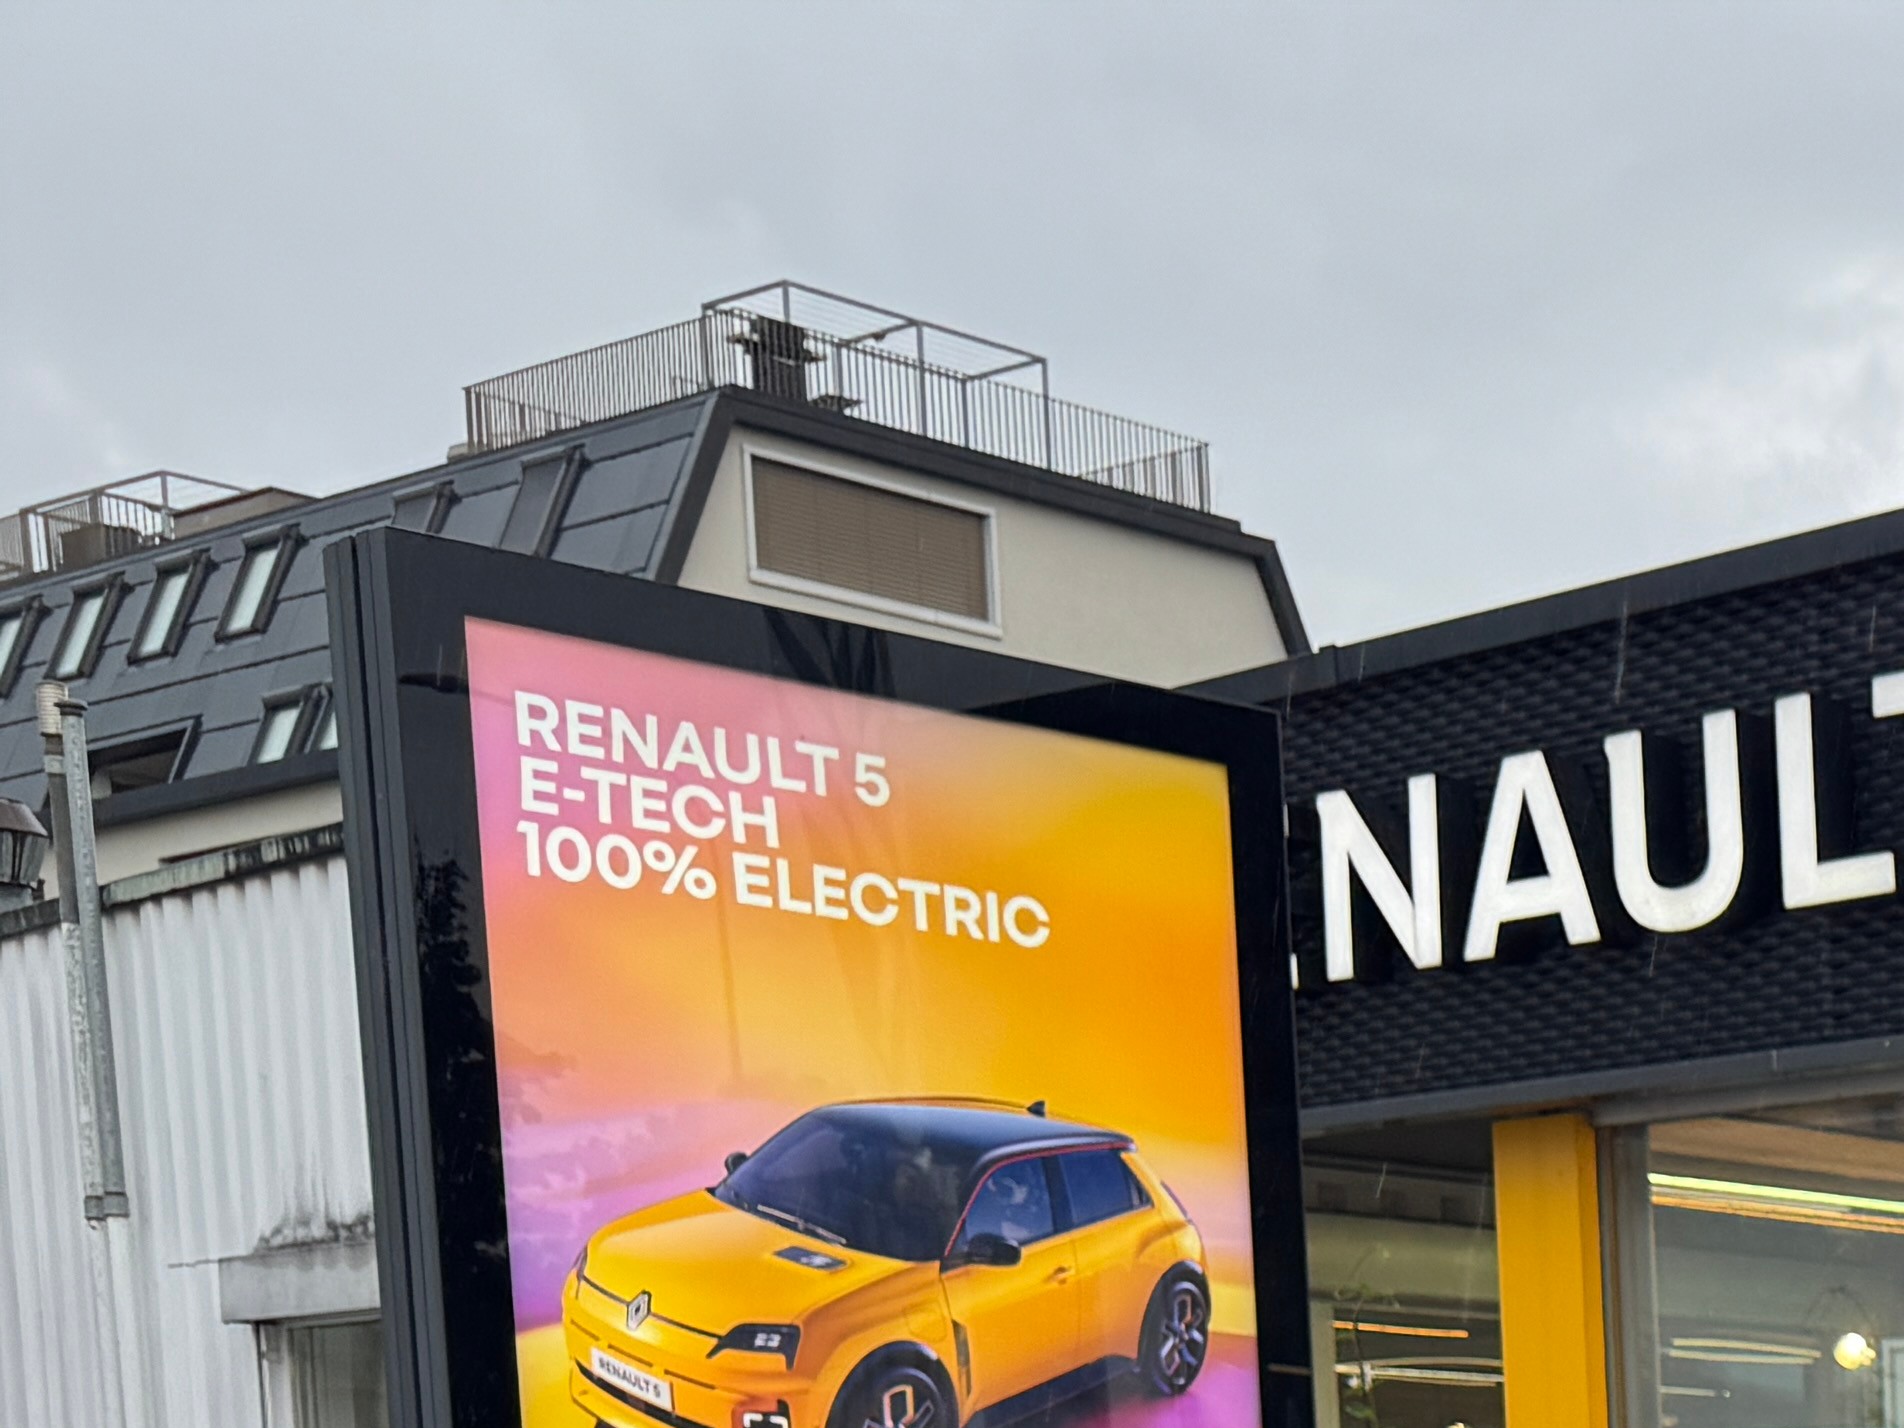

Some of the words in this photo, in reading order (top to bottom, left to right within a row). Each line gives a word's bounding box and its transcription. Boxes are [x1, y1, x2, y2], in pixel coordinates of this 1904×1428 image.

[515, 690, 840, 797] RENAULT
[854, 752, 891, 807] 5
[519, 755, 780, 848] E-TECH
[515, 821, 717, 900] 100%
[732, 852, 1051, 948] ELECTRIC
